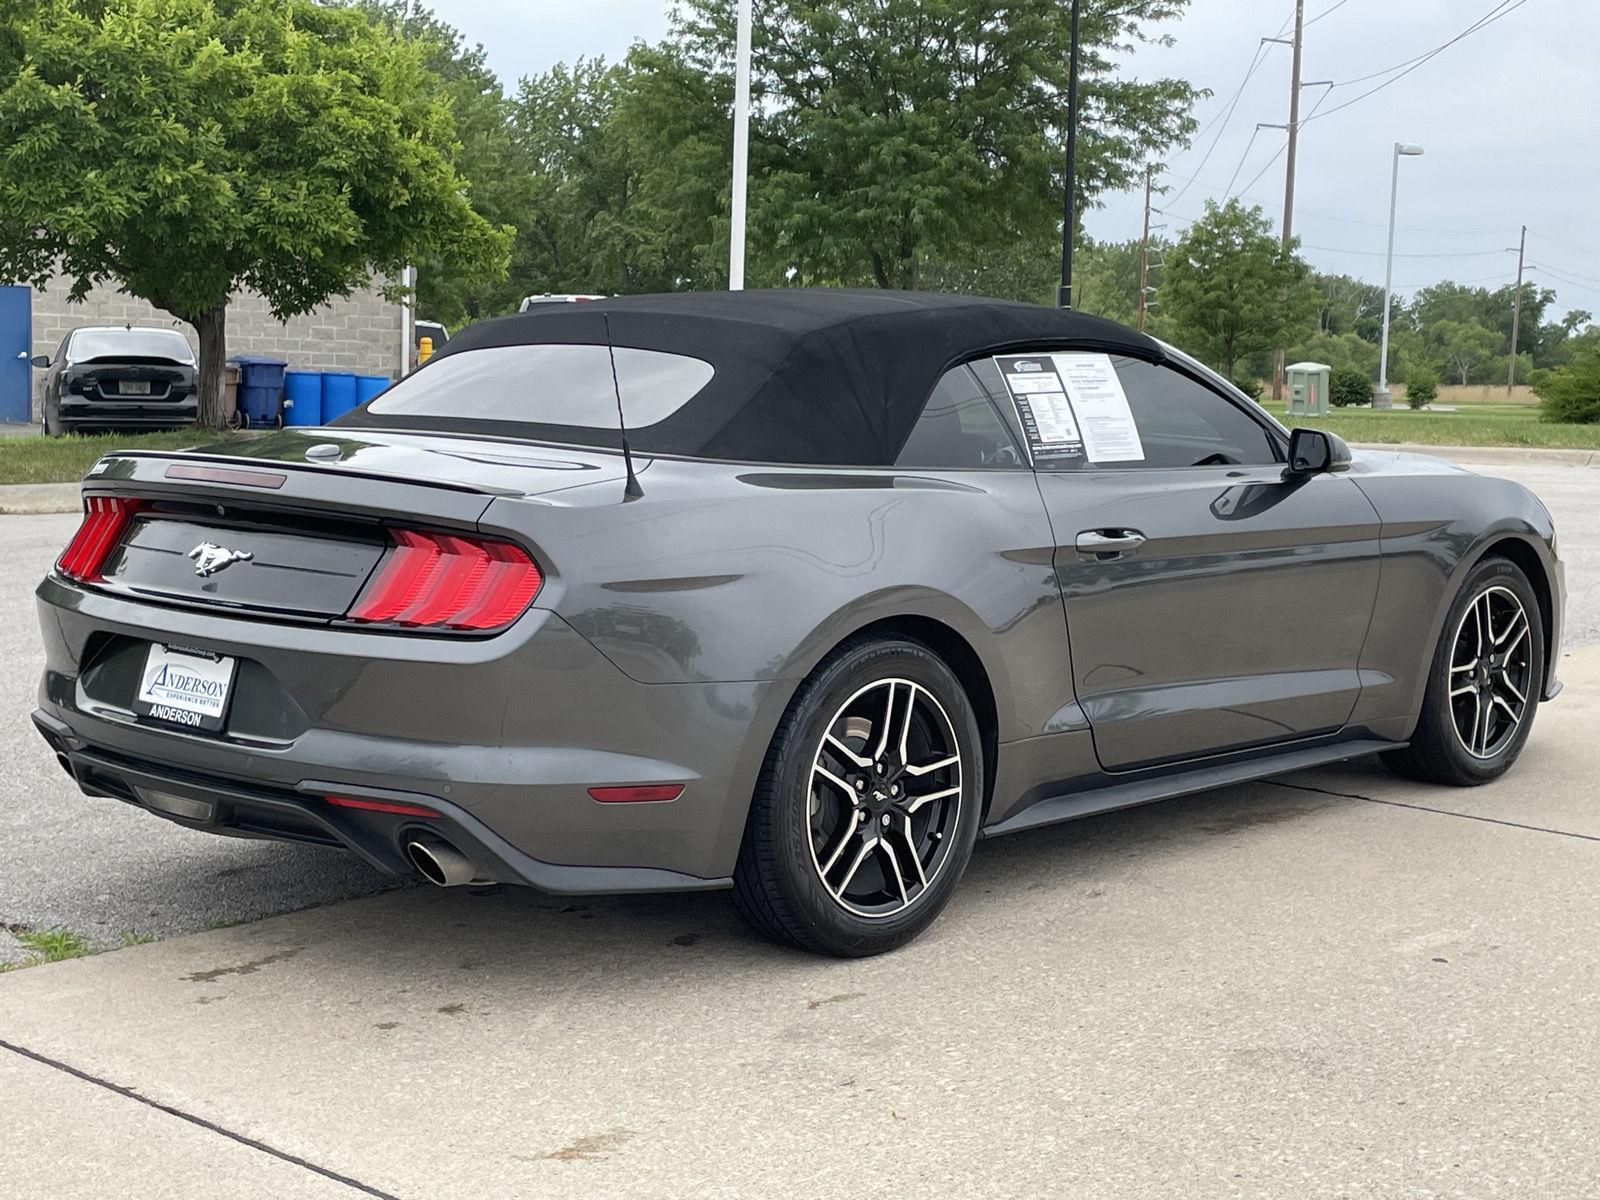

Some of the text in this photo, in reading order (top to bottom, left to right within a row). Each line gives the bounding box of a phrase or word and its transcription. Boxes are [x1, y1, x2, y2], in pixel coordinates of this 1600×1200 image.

[146, 663, 227, 697] ANDERSON
[166, 692, 220, 708] EXPERIENCE BETTER
[149, 704, 202, 726] ANDERSON
